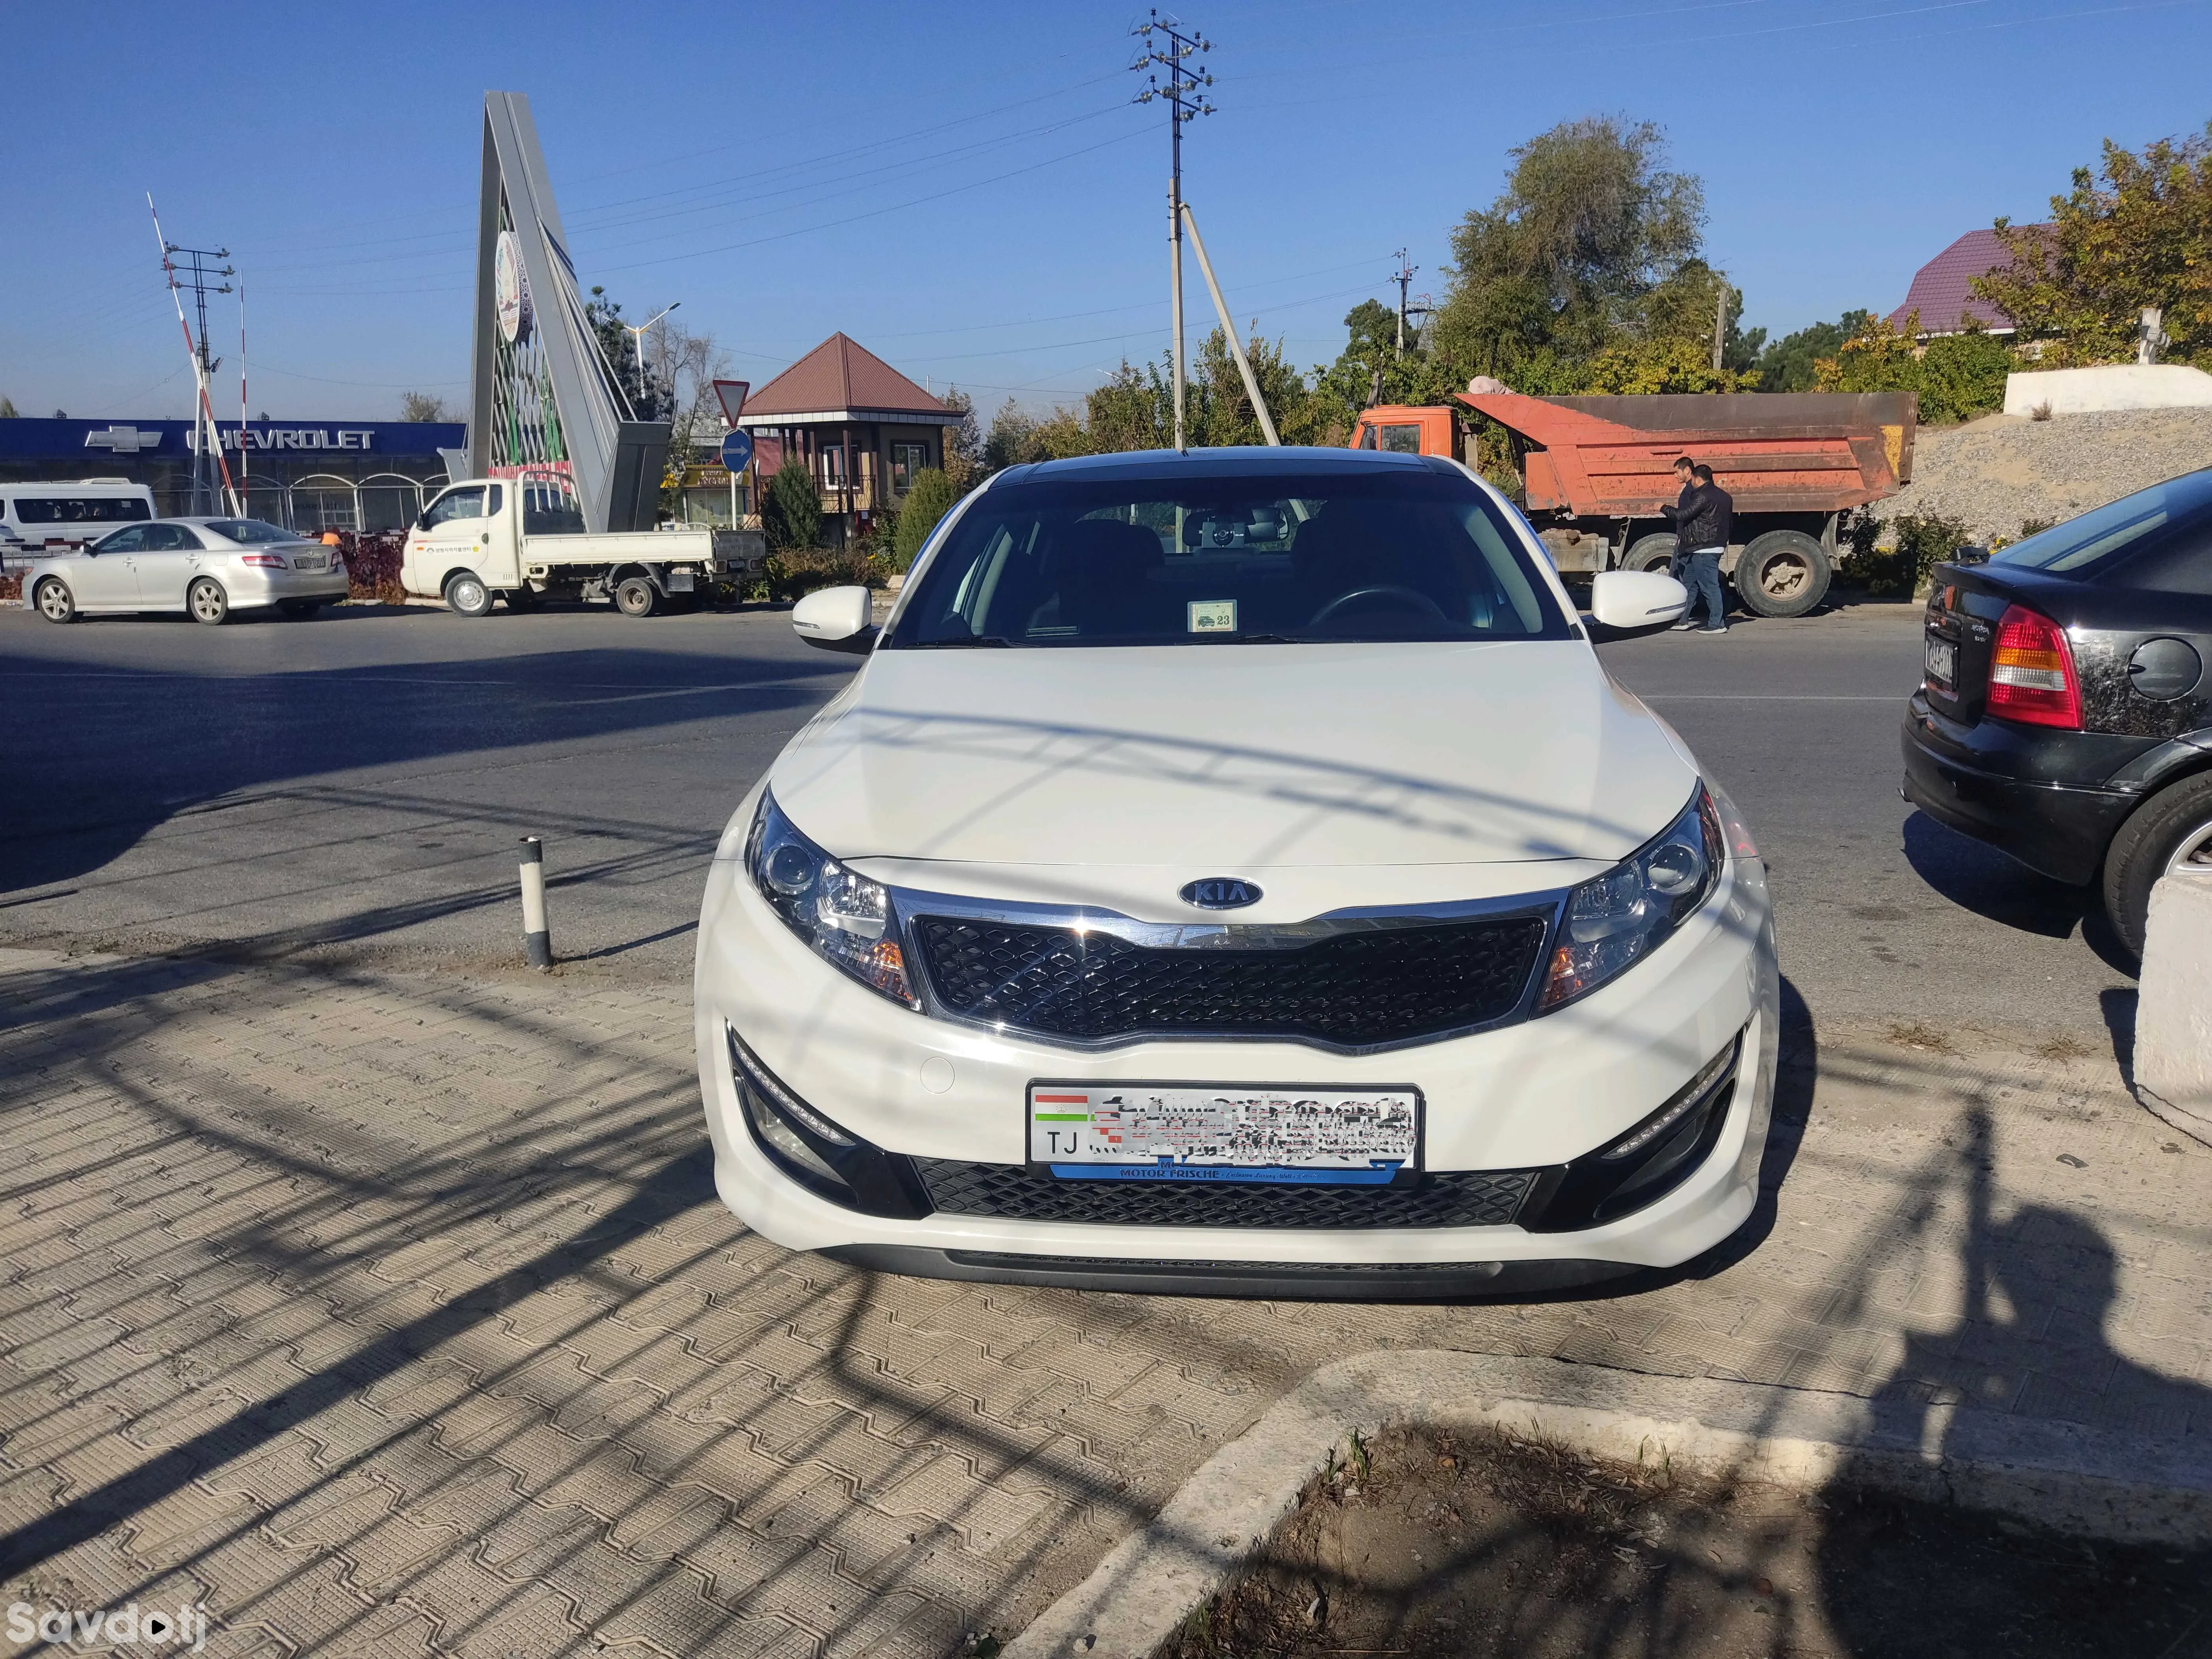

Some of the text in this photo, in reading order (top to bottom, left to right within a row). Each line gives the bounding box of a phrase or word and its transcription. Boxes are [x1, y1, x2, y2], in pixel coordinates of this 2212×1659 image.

[186, 429, 375, 450] CHEVROLET
[1217, 615, 1230, 625] 23
[1194, 883, 1249, 901] KIA
[1047, 1131, 1077, 1154] TJ
[1120, 1168, 1165, 1177] MOTOR
[1170, 1169, 1219, 1178] FRISCHE
